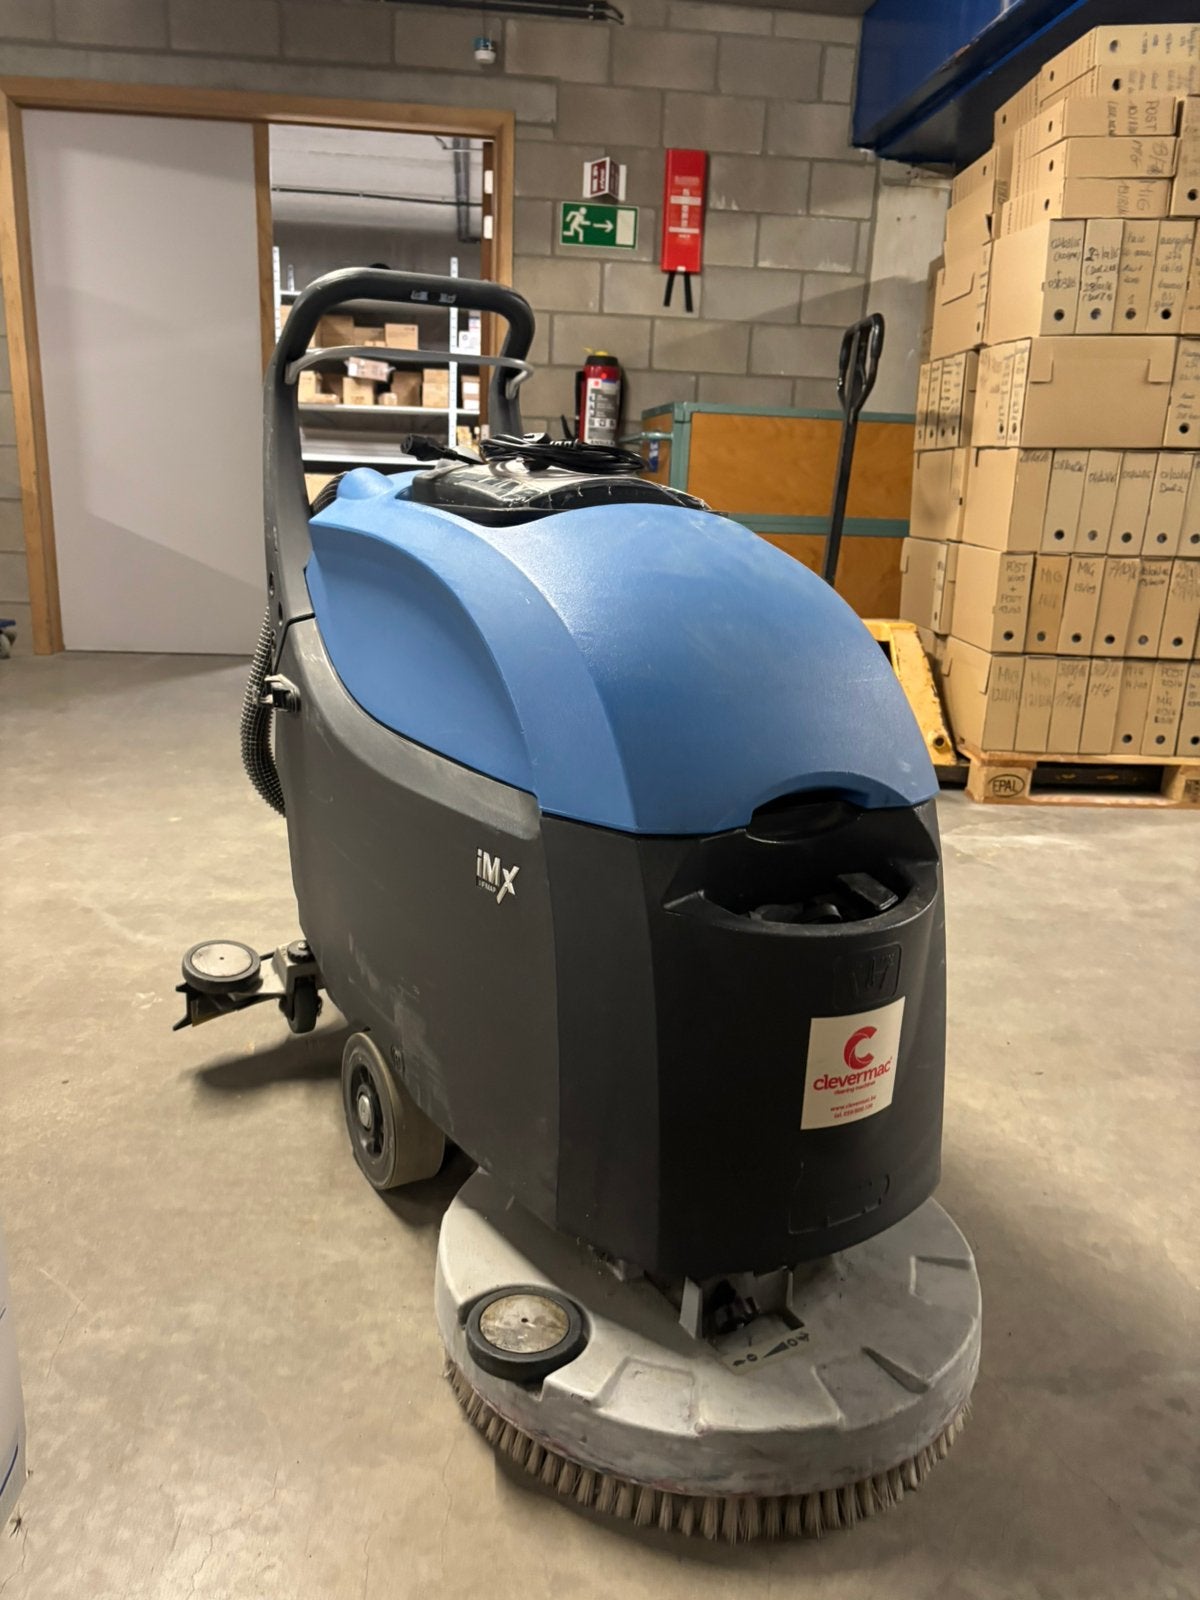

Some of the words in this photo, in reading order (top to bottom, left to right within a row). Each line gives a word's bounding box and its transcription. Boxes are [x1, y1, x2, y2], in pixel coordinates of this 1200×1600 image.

[1145, 100, 1160, 132] POST
[992, 779, 1018, 793] EPAL
[813, 1060, 892, 1091] clevermac
